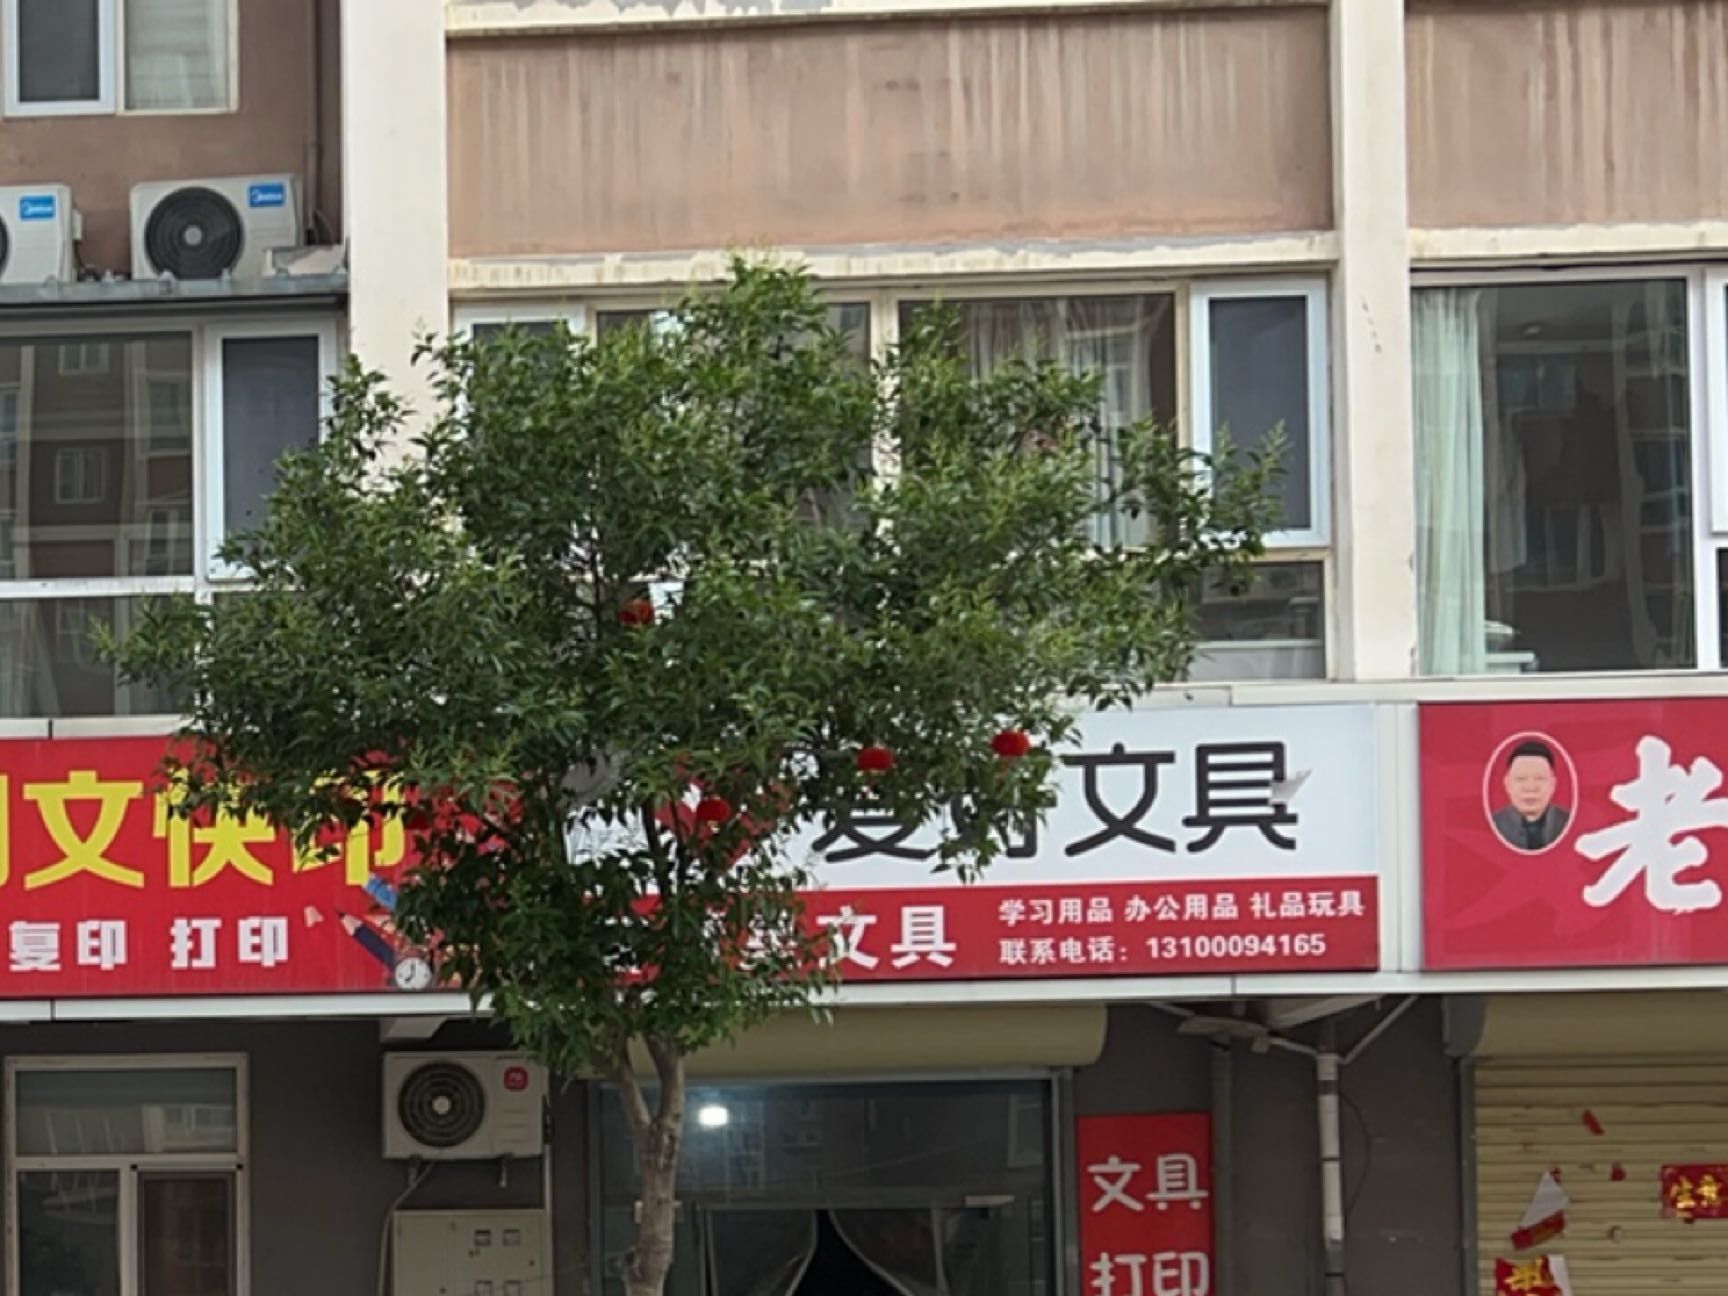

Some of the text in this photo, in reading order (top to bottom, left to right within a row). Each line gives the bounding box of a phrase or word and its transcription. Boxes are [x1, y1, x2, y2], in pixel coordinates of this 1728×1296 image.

[998, 890, 1365, 927] 学习用品 办公用品 礼品玩具
[8, 916, 289, 972] 复印 打印
[1087, 1153, 1209, 1212] 文具
